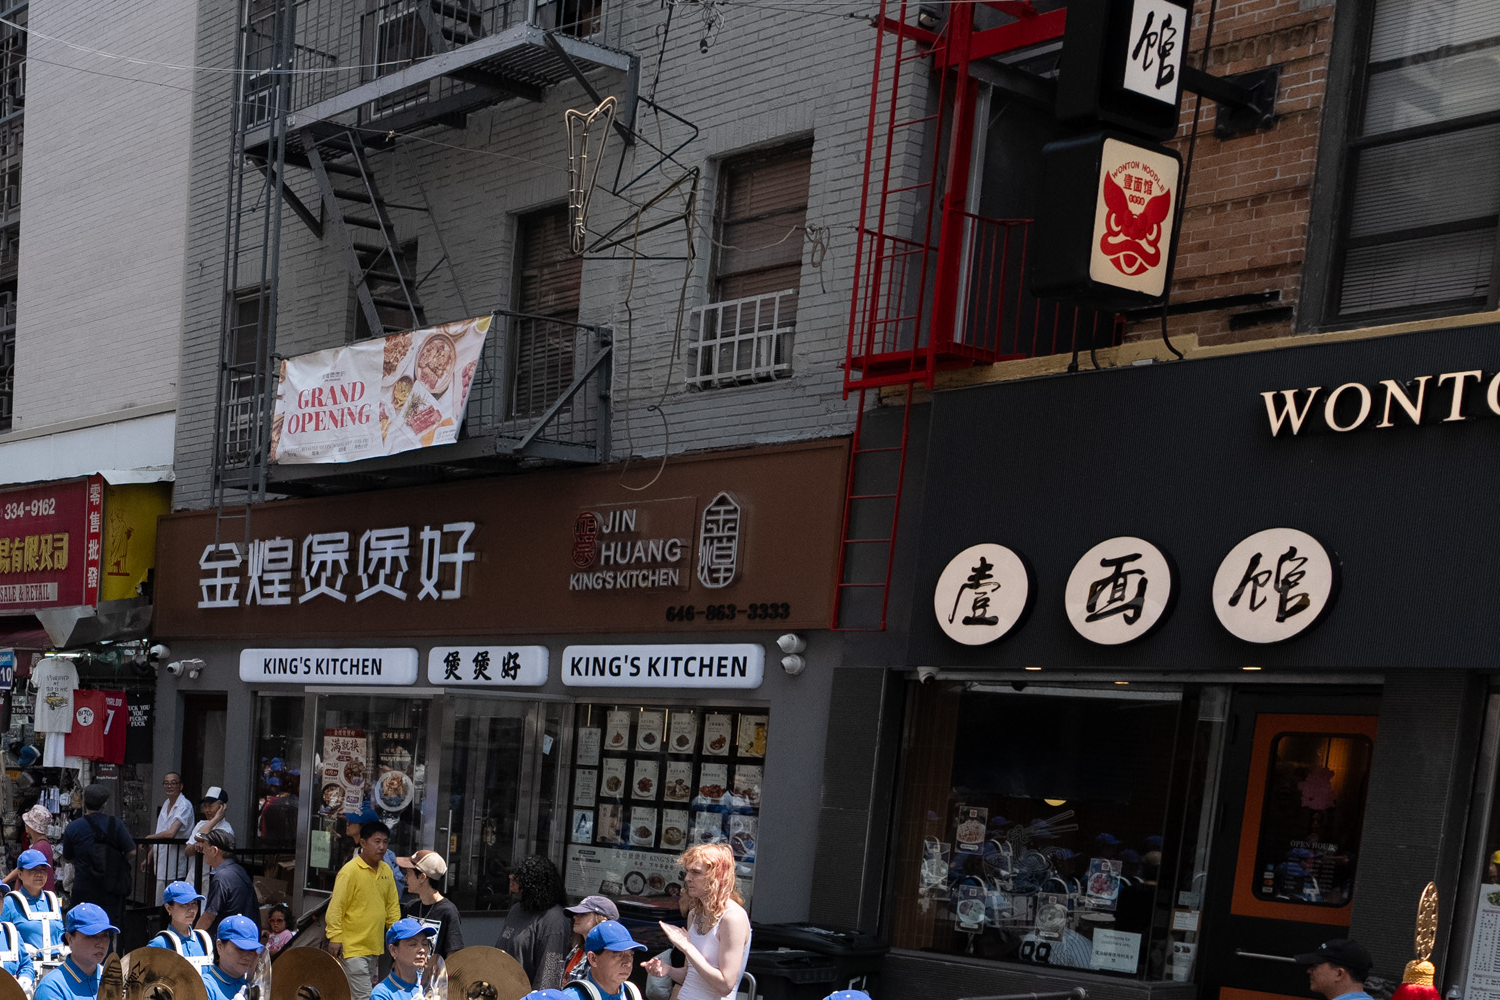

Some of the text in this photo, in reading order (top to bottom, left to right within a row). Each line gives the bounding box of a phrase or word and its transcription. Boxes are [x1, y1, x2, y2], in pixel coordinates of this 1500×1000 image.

[1112, 161, 1166, 193] WONTON NOODLE
[298, 381, 365, 410] GRAND
[1260, 370, 1500, 437] WONT
[287, 403, 371, 435] OPENING
[5, 498, 56, 520] 334-9162
[602, 509, 637, 534] JIN
[197, 521, 476, 608] 金煌煲煲好
[601, 538, 683, 566] HUANG
[19, 586, 24, 601] &
[26, 584, 50, 600] RETAIL
[569, 569, 680, 591] KING'S KITCHEN
[665, 602, 791, 623] 646-863-3333
[263, 656, 382, 675] KING'S KITCHEN
[443, 650, 520, 682] 煲煲好
[570, 654, 748, 678] KING'S KITCHEN
[104, 709, 115, 735] 7
[1290, 840, 1338, 851] OPEN HOURS
[650, 855, 669, 863] KING'S
